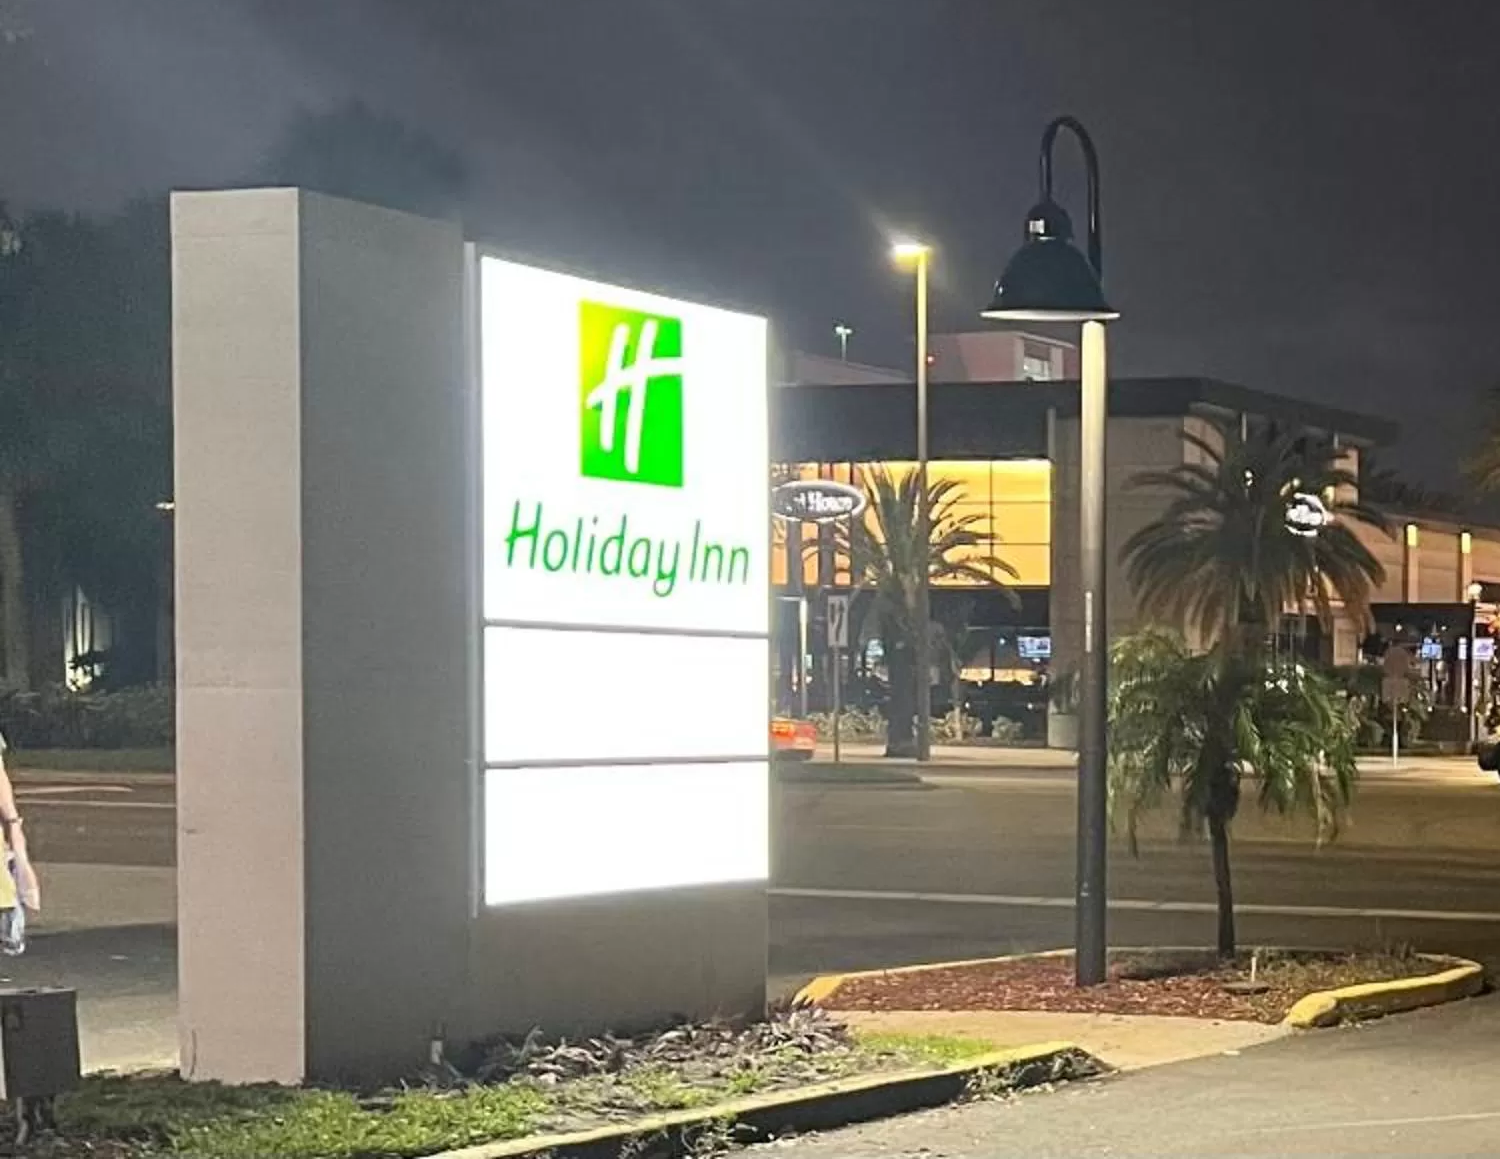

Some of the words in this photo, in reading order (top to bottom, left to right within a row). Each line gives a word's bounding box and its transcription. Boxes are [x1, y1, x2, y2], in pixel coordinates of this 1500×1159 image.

[585, 319, 684, 475] H
[504, 497, 680, 598] Holiday
[688, 517, 750, 585] Inn
